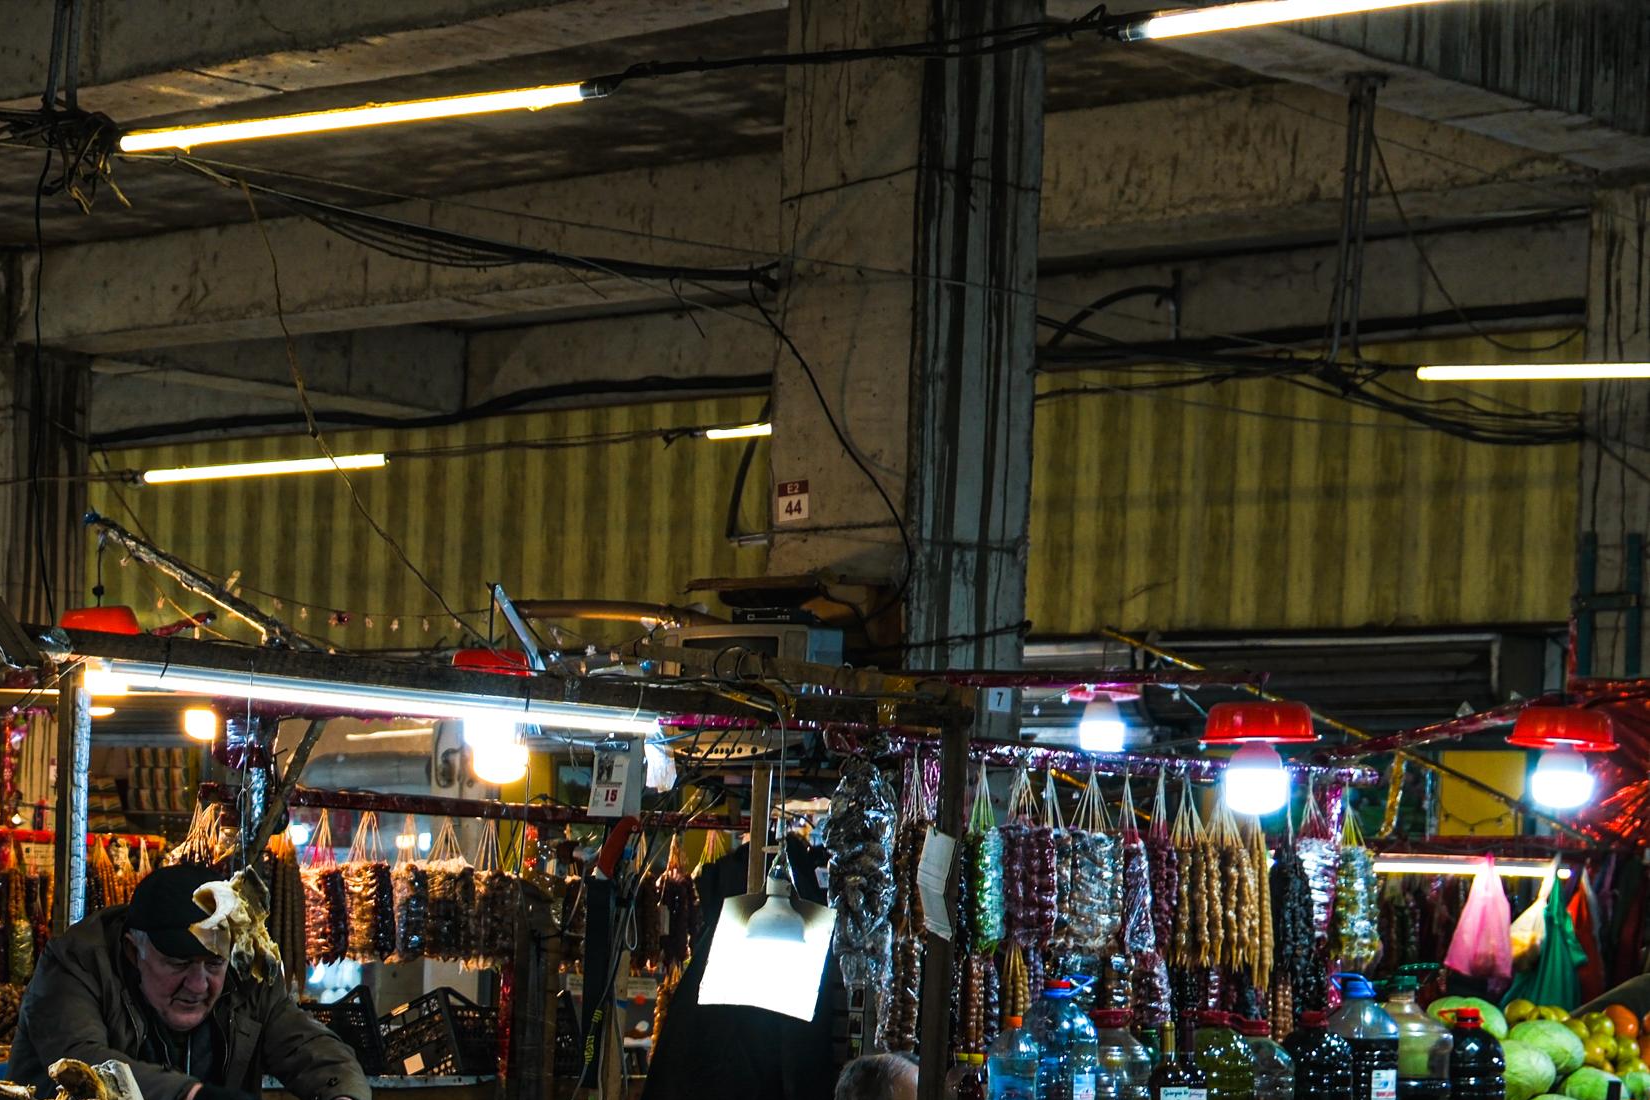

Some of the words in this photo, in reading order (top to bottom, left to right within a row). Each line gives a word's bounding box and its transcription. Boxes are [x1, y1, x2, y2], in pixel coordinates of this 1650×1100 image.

[785, 500, 802, 515] 44
[997, 692, 1003, 707] 7
[605, 789, 618, 802] 15
